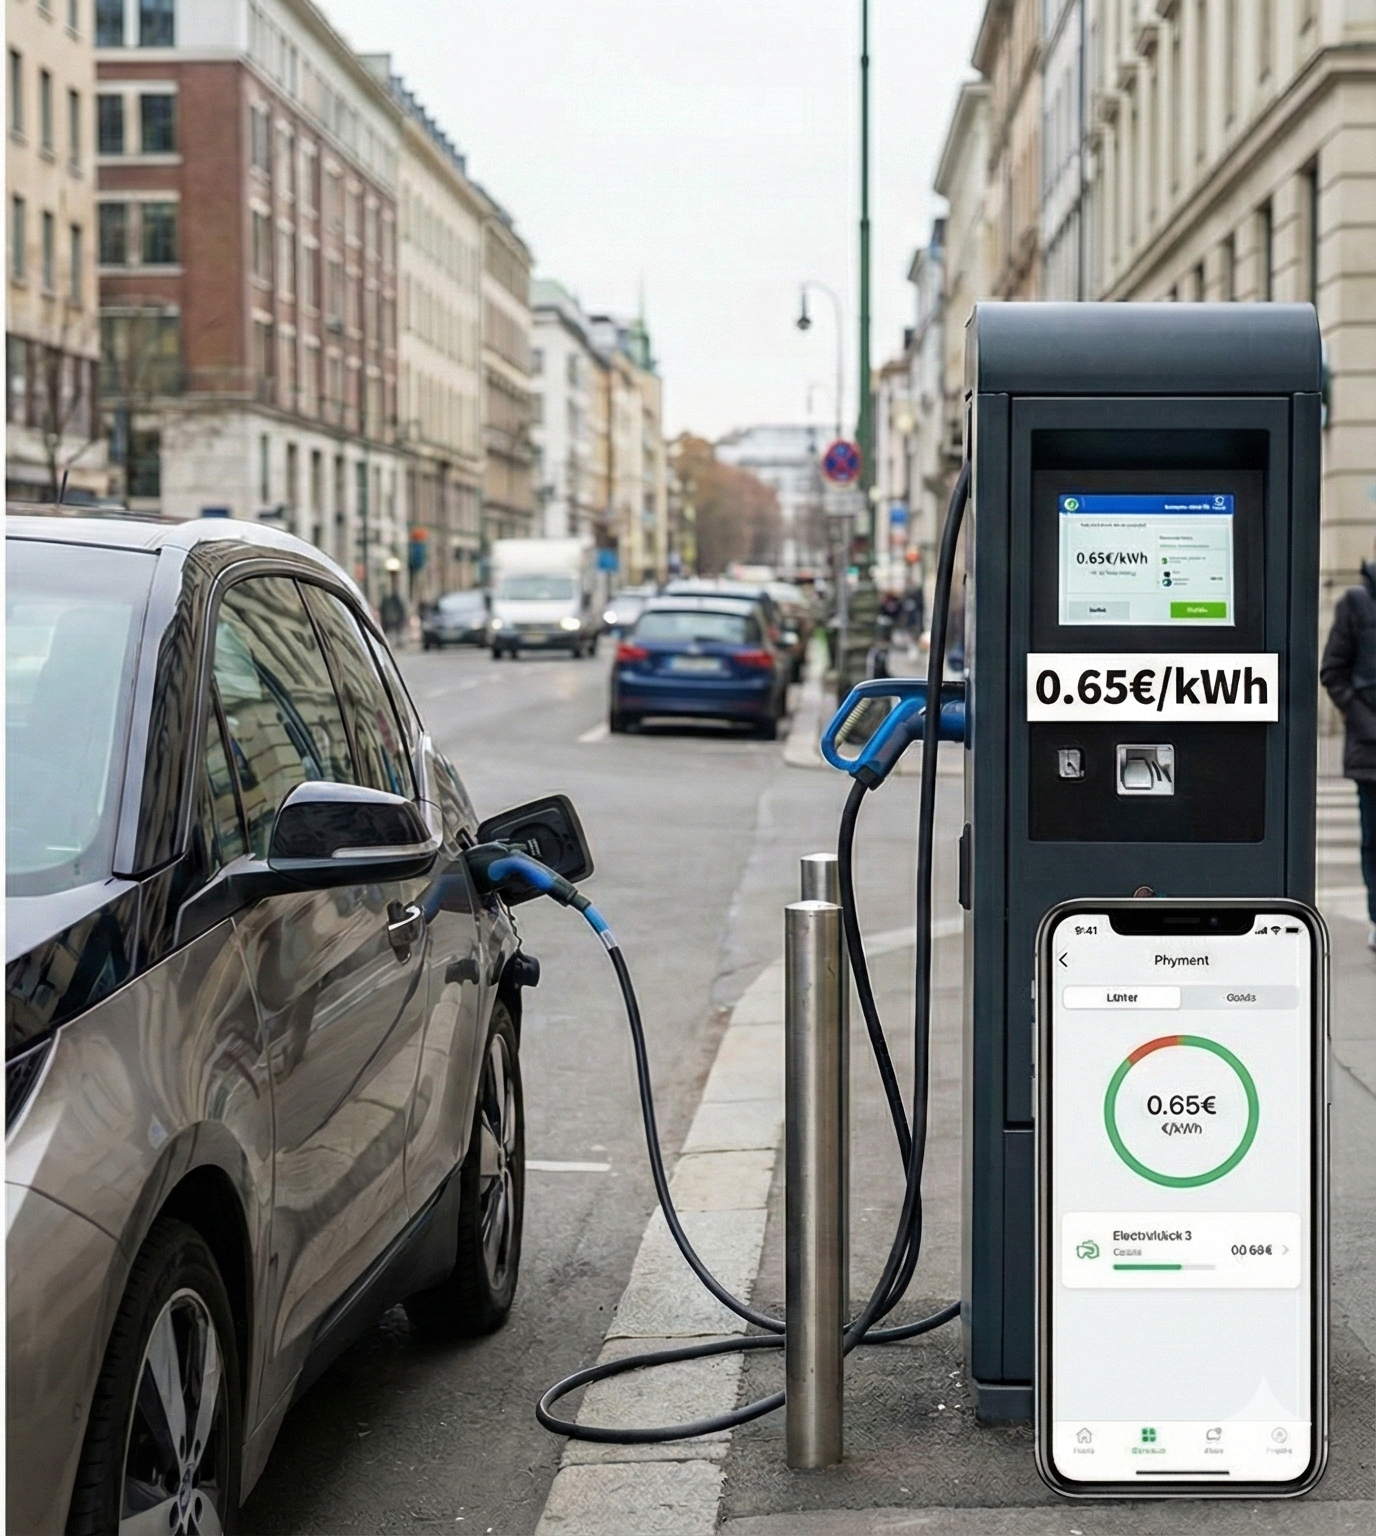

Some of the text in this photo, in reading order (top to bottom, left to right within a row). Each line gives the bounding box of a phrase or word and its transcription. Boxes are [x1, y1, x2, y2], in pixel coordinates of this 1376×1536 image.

[1076, 552, 1148, 565] 0.65€/kWh
[1154, 955, 1210, 968] Phyment
[1147, 1095, 1217, 1116] 0.65€
